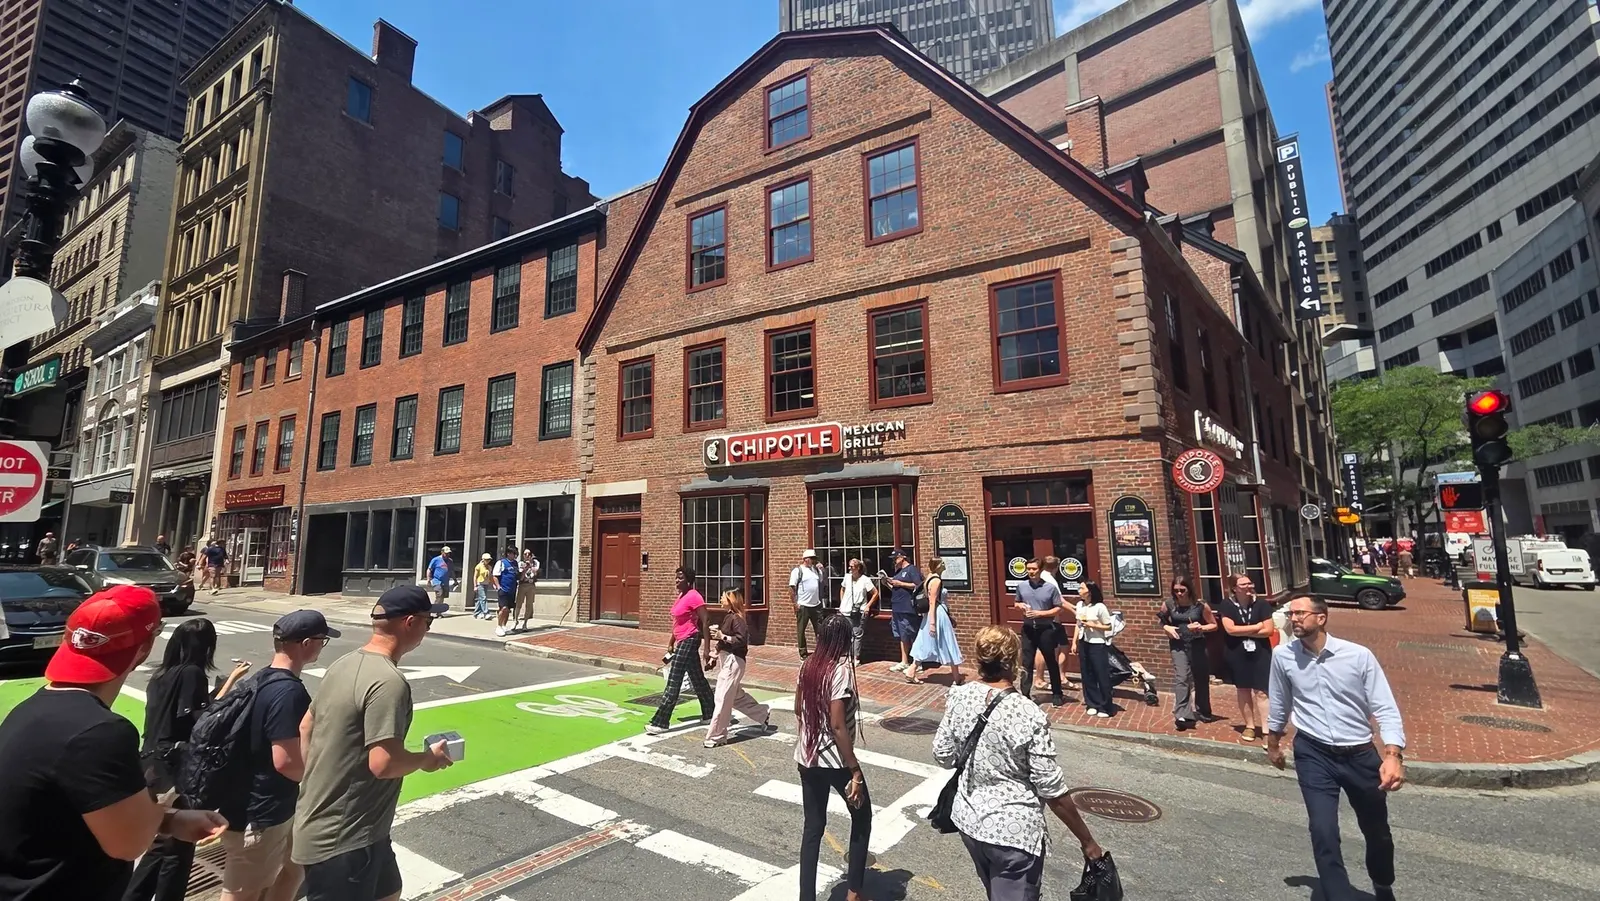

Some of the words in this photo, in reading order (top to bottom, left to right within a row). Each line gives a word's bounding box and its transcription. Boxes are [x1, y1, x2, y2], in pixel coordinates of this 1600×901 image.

[1286, 164, 1301, 215] PUBLIC
[1296, 231, 1313, 294] PARKING
[23, 364, 46, 389] SCHOOL
[843, 420, 905, 436] MEXICAN
[730, 430, 832, 456] CHIPOTLE
[843, 435, 882, 449] GRILL
[1175, 450, 1220, 469] CHIPOTLE
[1348, 464, 1359, 501] PARKING
